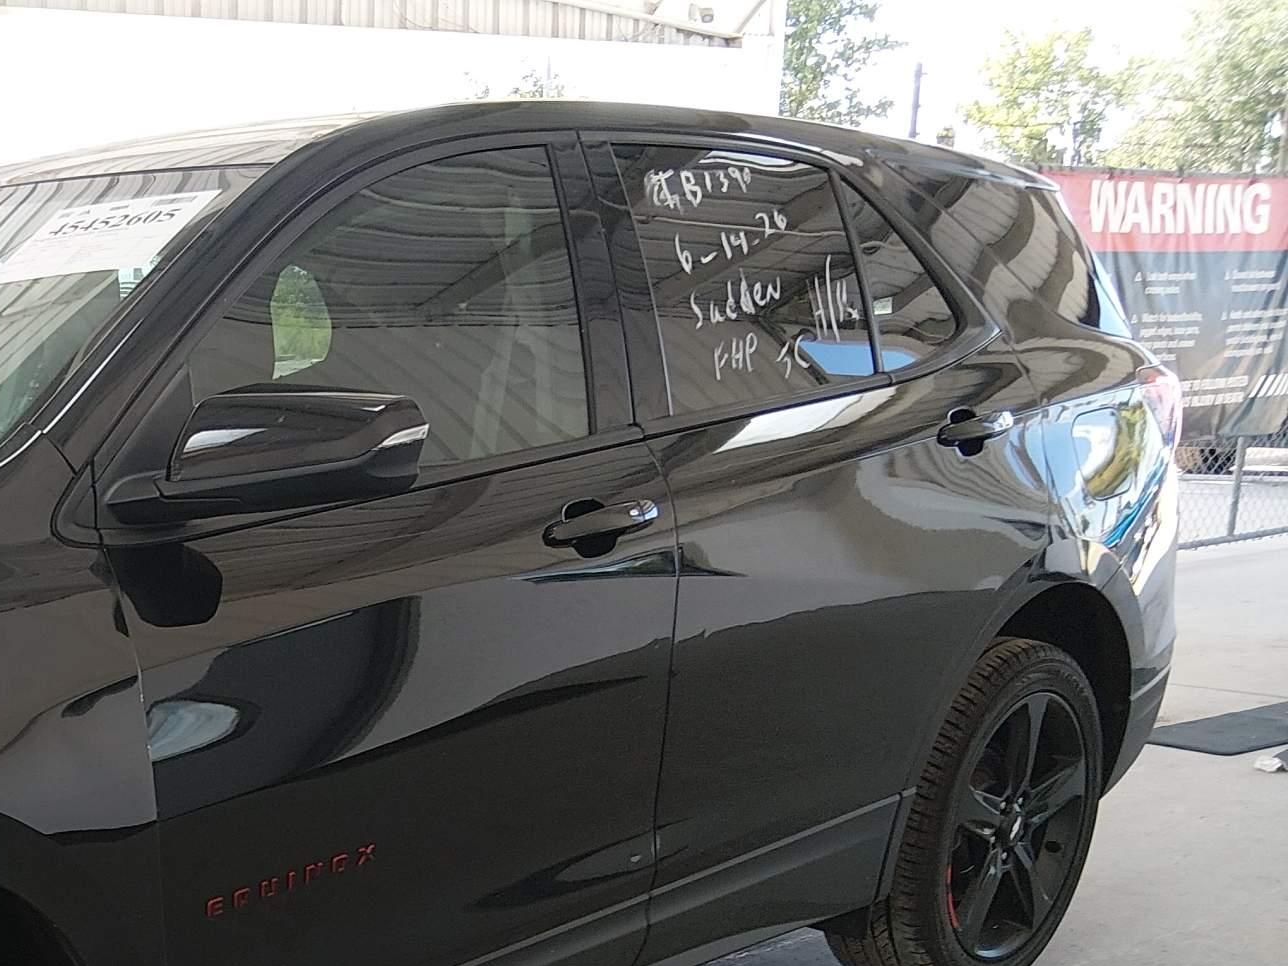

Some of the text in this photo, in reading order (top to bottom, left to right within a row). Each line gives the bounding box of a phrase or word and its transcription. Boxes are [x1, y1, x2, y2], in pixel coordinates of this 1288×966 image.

[49, 207, 183, 236] 45452605
[1089, 179, 1272, 235] WARNING
[205, 843, 376, 918] EQUINOX
